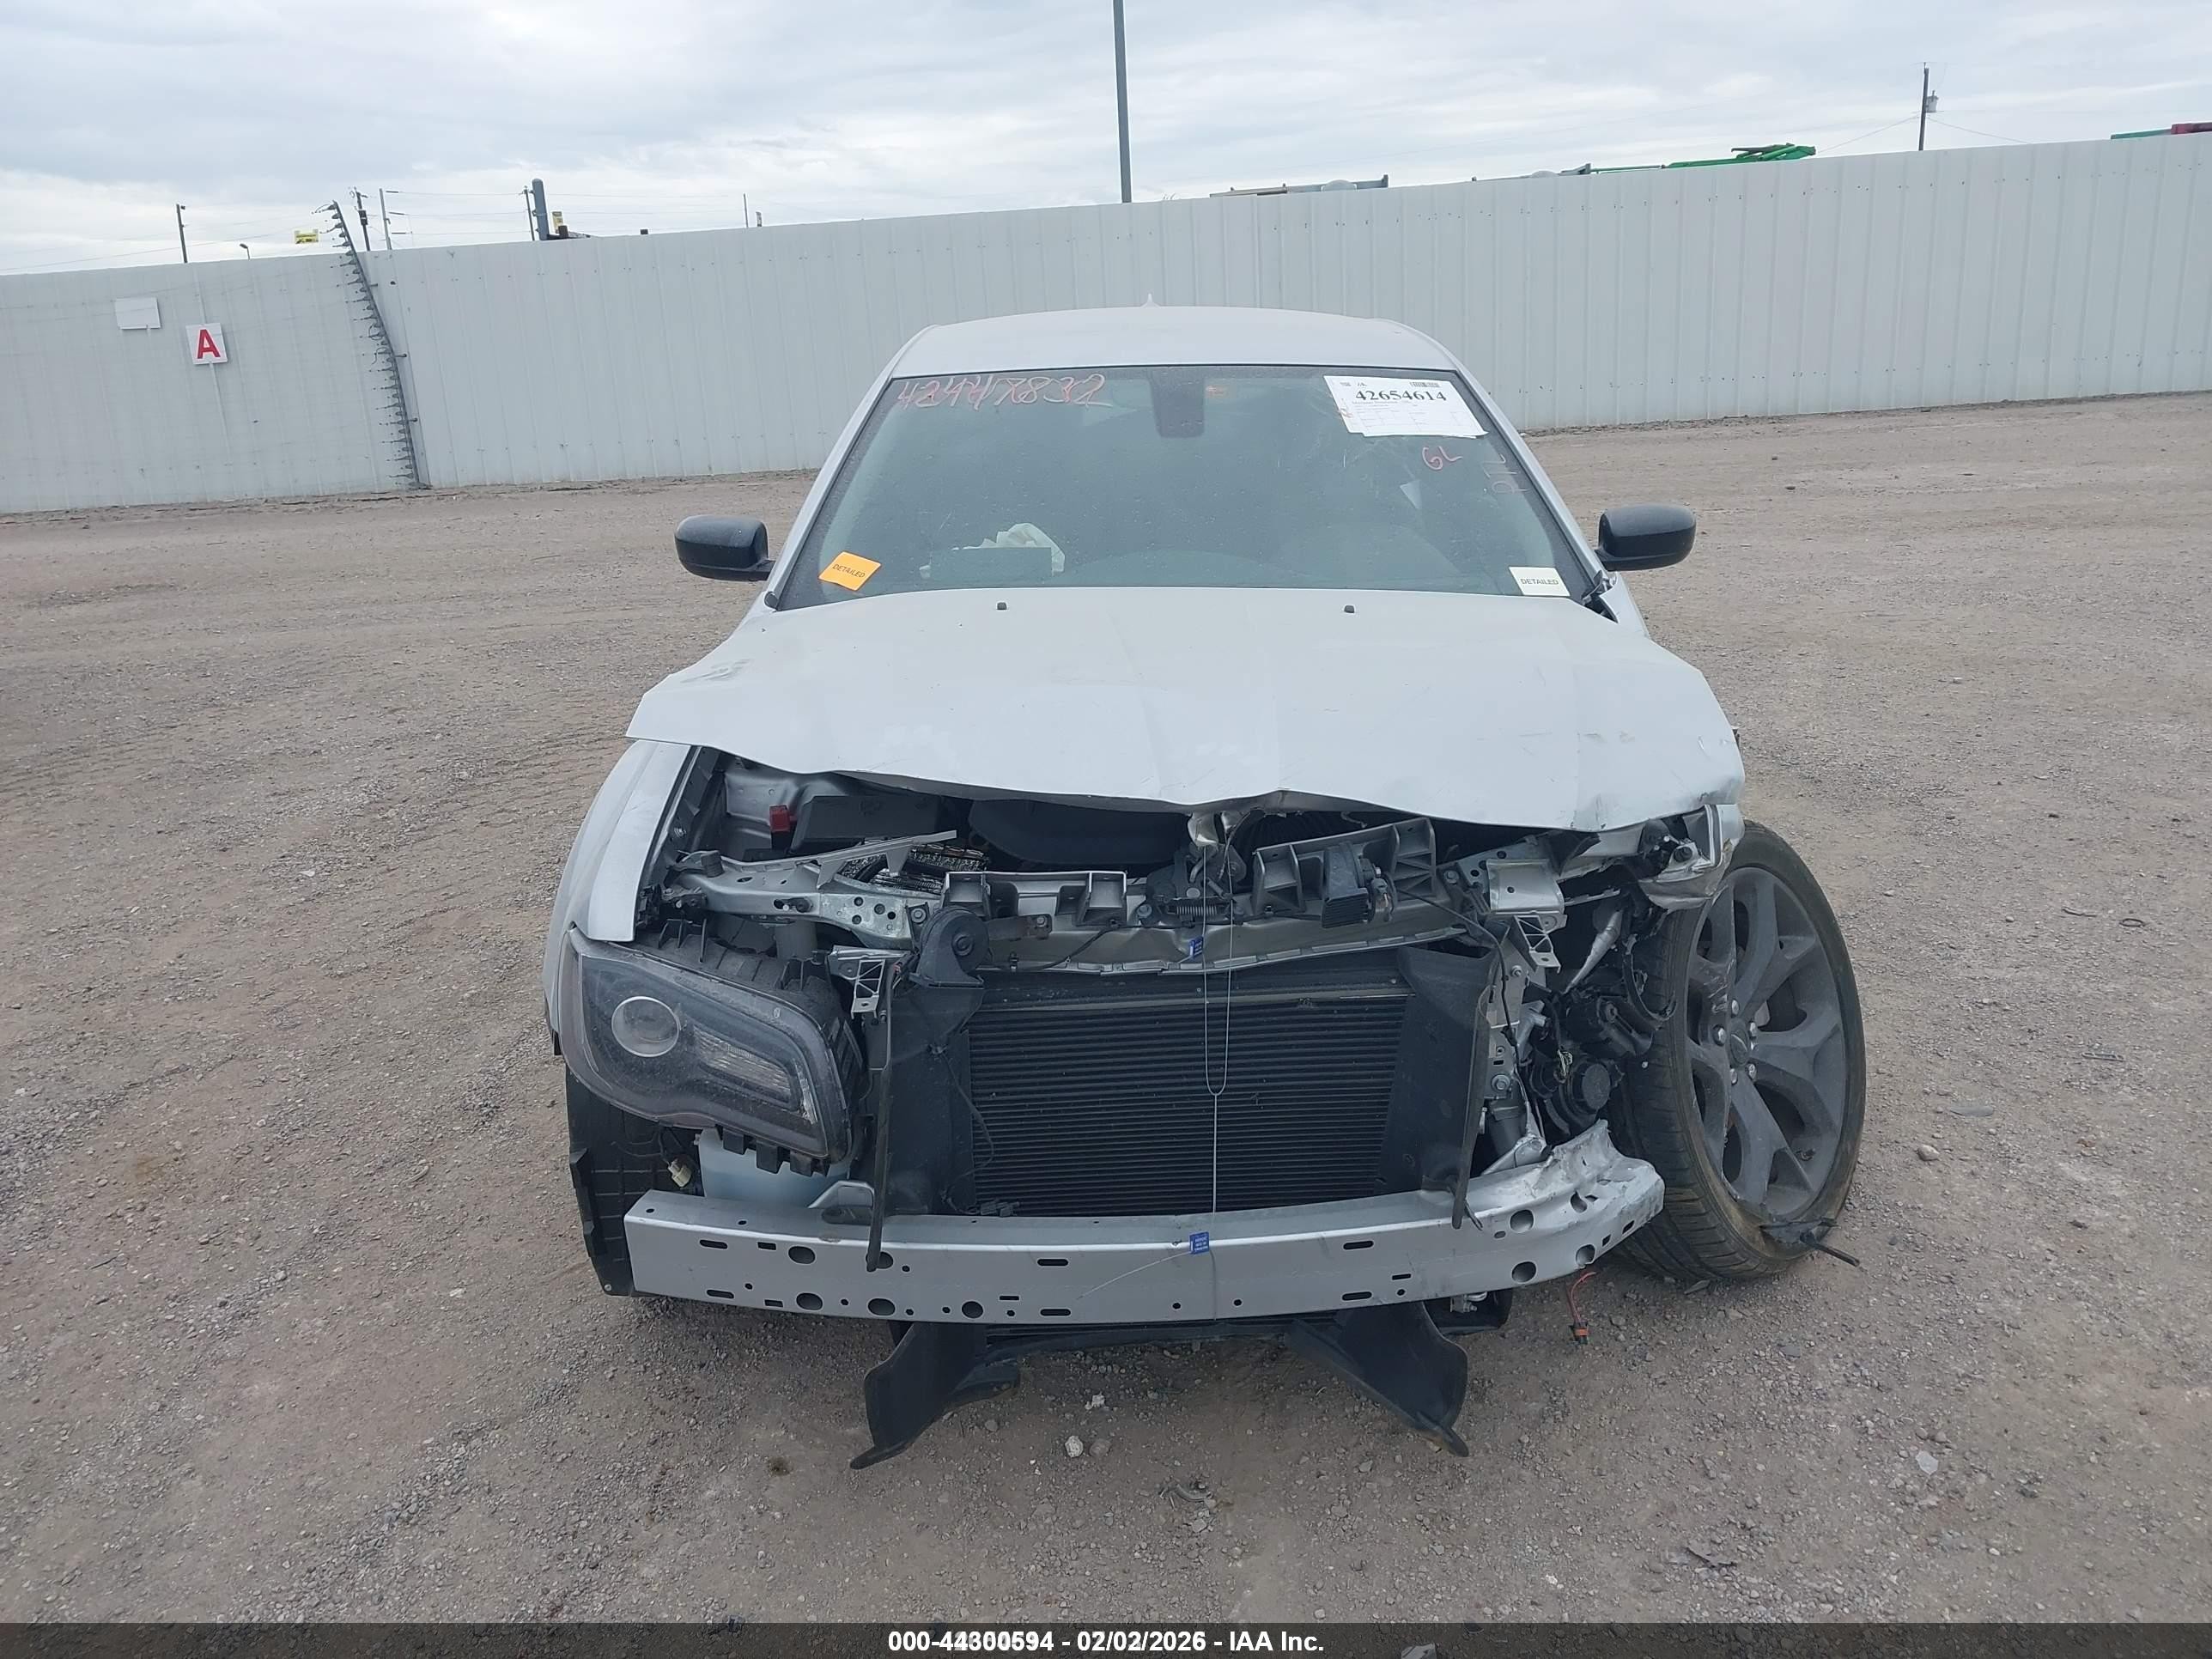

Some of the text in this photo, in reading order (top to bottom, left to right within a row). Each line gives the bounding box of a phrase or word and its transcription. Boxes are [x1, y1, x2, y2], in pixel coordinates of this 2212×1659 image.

[198, 329, 221, 359] A
[1355, 390, 1447, 402] 42654614
[832, 563, 866, 578] DETAILED
